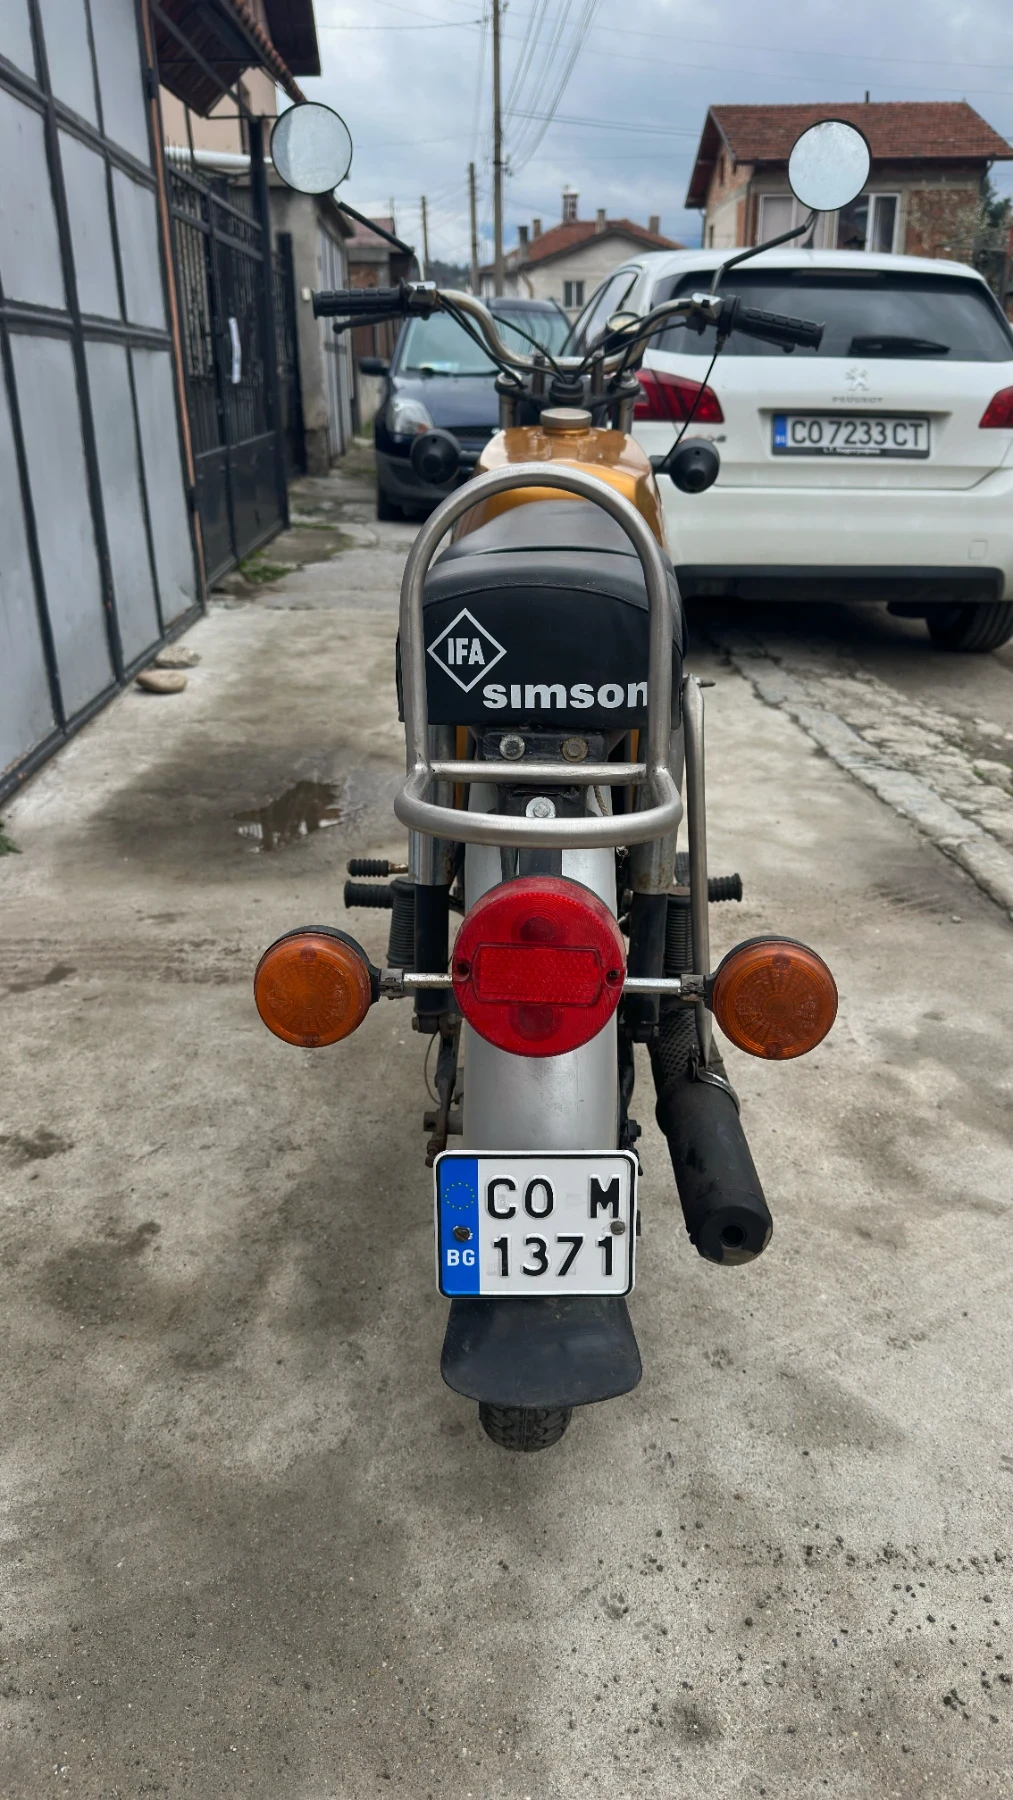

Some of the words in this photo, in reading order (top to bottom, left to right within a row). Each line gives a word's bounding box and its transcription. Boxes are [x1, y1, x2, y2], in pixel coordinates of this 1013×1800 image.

[792, 420, 823, 444] CO
[828, 420, 887, 445] 7233
[893, 422, 924, 446] CT
[447, 638, 485, 665] IFA
[482, 681, 648, 709] simson
[487, 1178, 554, 1219] CO
[590, 1178, 620, 1219] M
[447, 1249, 475, 1266] BG
[494, 1236, 613, 1276] 1371
